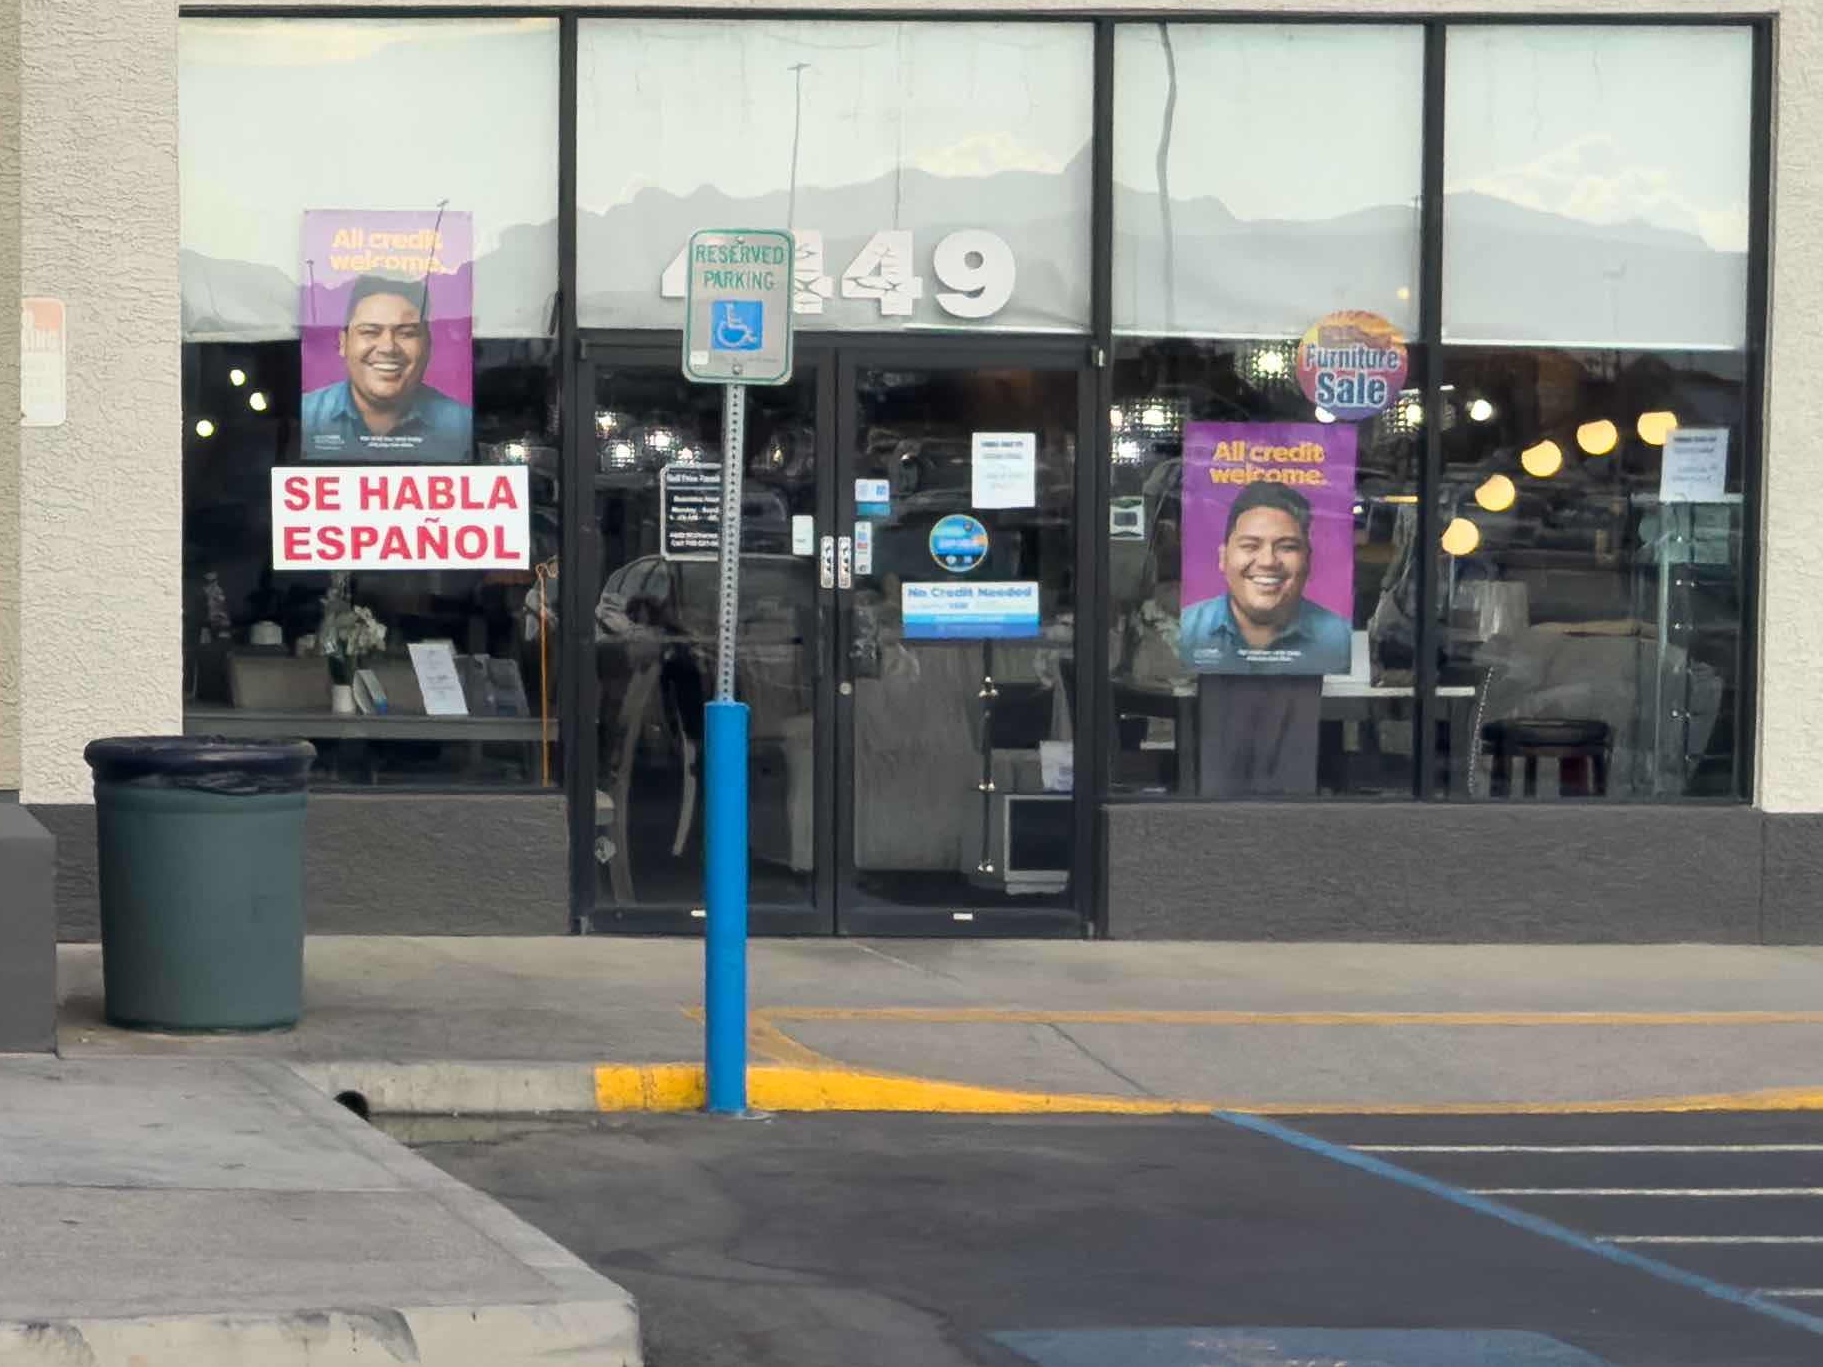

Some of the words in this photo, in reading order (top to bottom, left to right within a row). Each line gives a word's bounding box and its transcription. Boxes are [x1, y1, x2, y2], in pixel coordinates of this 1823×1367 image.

[331, 228, 364, 249] All
[695, 243, 785, 265] RESERVED
[704, 270, 775, 291] PARKING
[1304, 343, 1399, 371] Furniture
[1315, 370, 1388, 407] Sale
[1213, 440, 1246, 462] All
[1251, 440, 1325, 463] credit
[1210, 463, 1328, 486] welcome.
[284, 476, 341, 511] SE
[359, 475, 517, 510] HABLA
[283, 517, 521, 561] ESPAÑOL
[908, 587, 928, 598] No
[932, 586, 973, 598] Credit
[978, 586, 1032, 598] Needed
